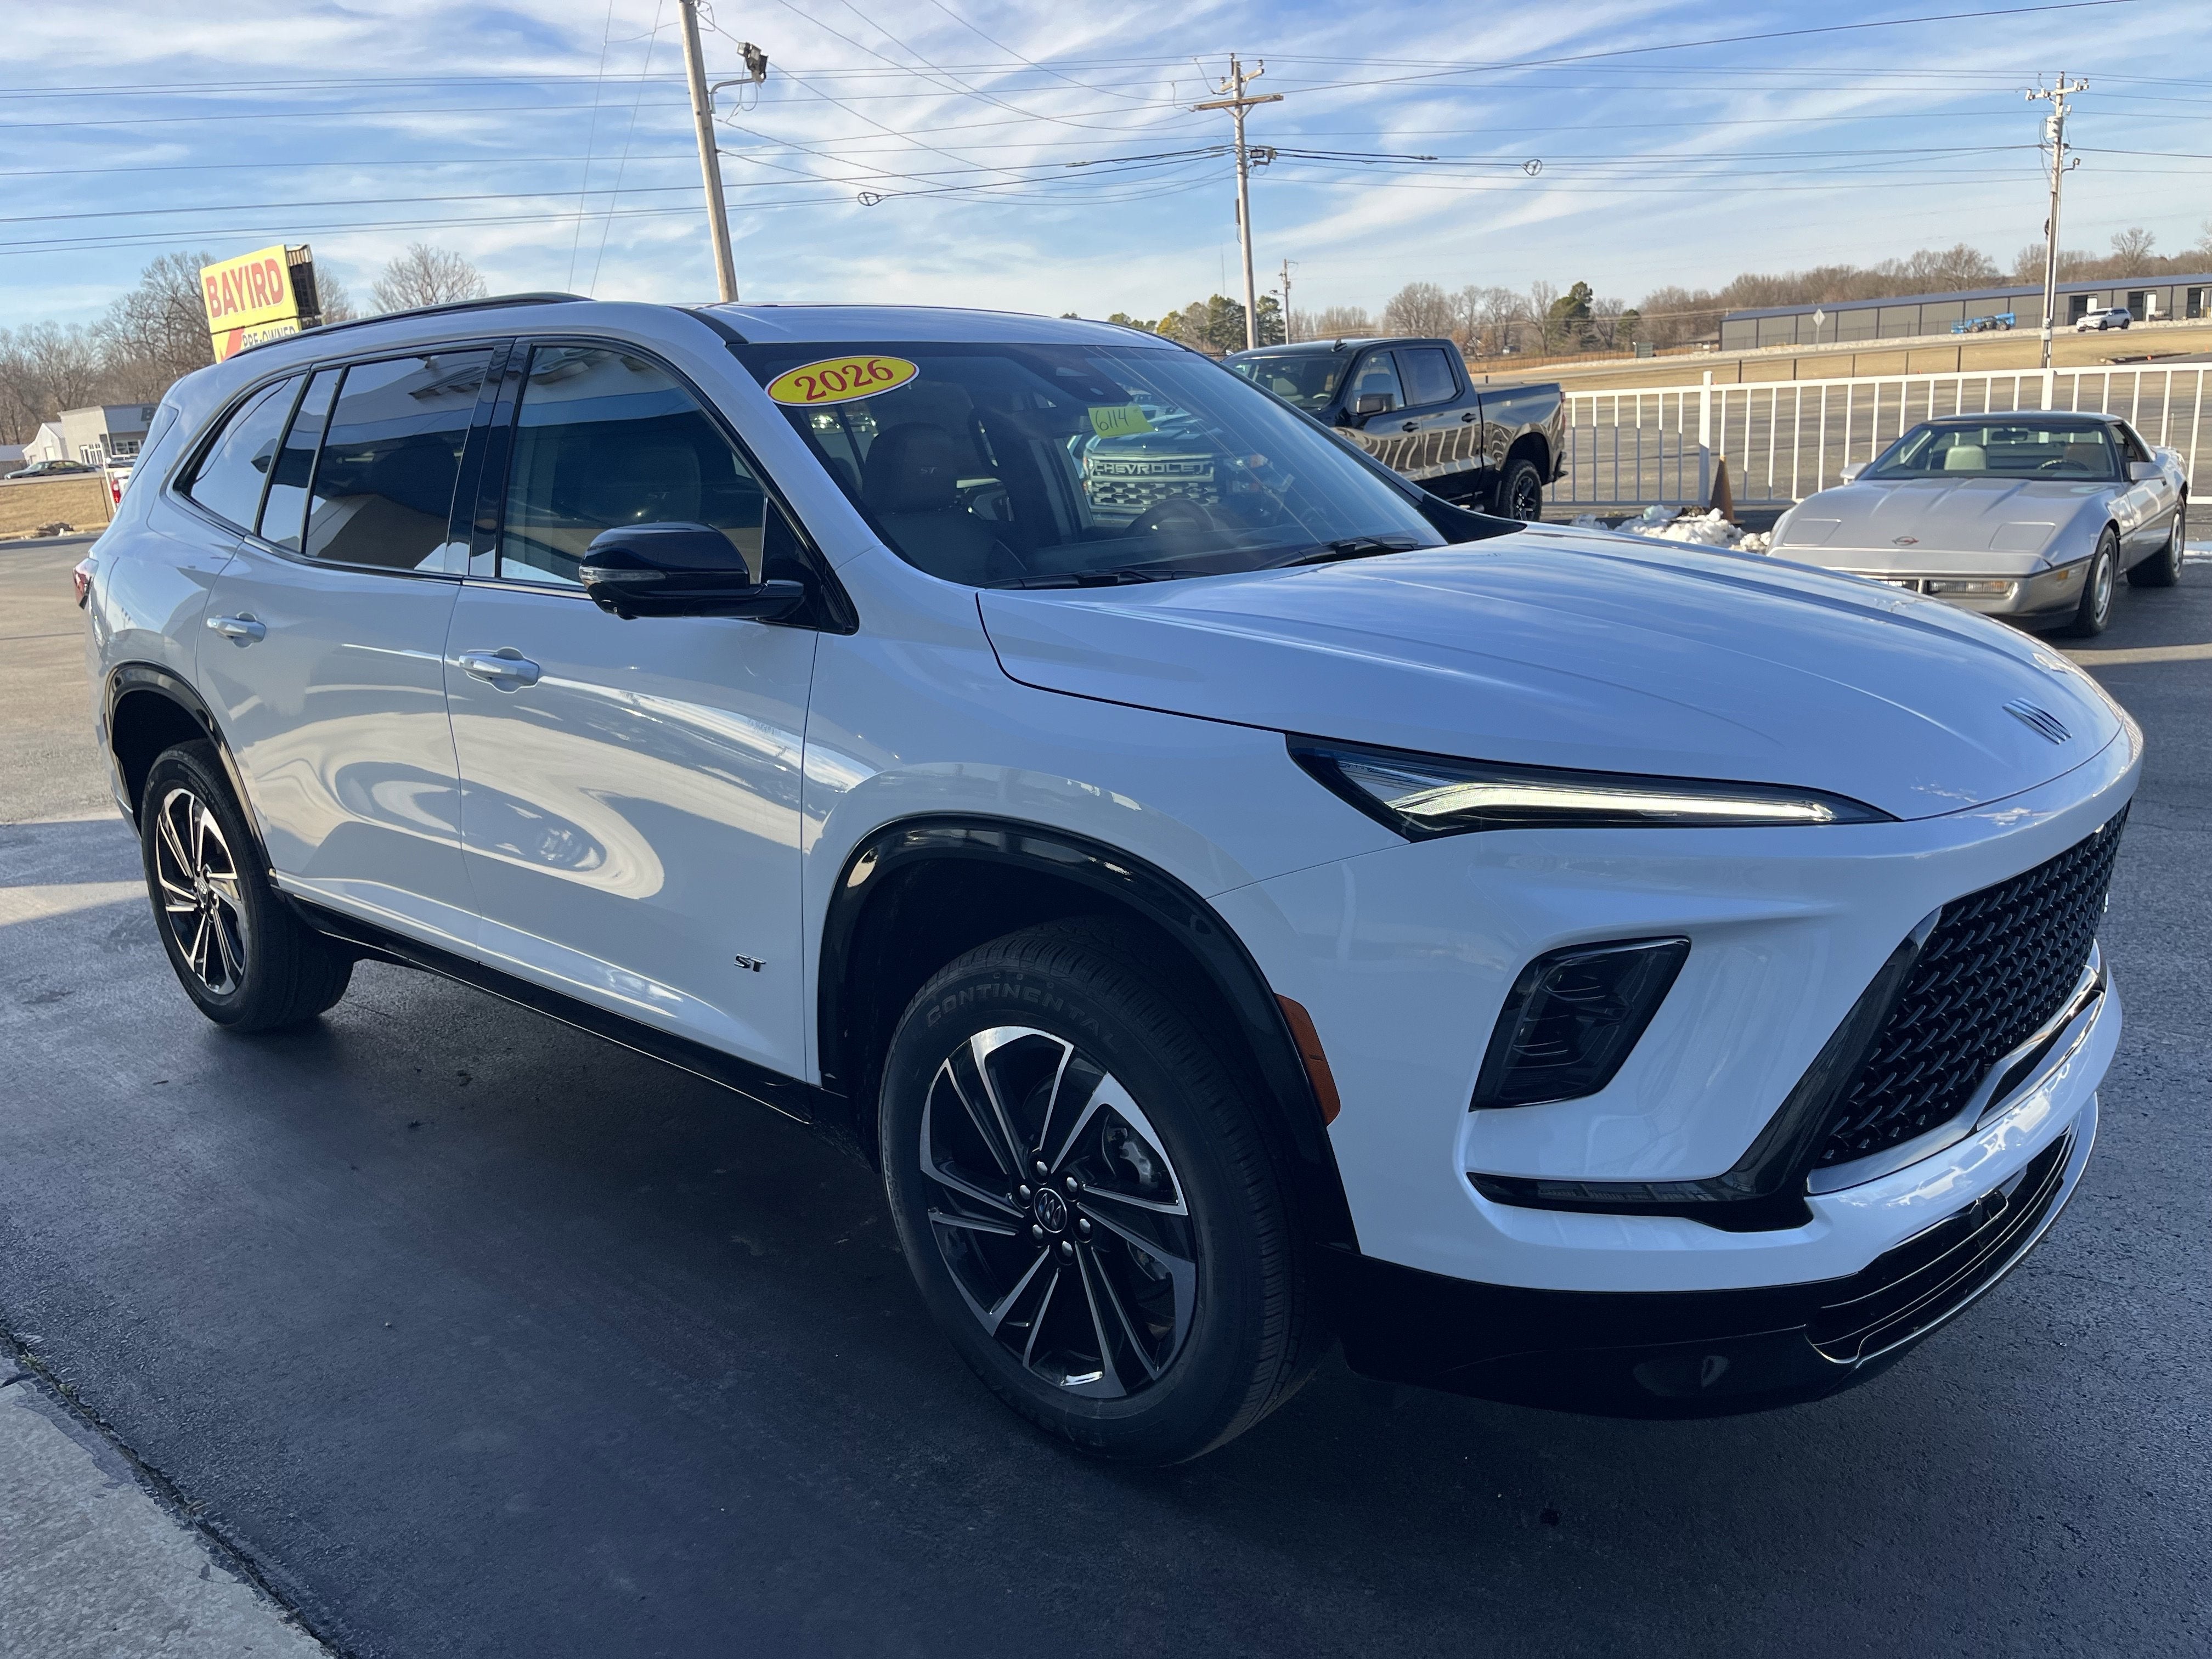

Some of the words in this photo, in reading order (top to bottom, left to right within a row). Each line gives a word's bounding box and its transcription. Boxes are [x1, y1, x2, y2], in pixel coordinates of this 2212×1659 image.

[205, 258, 284, 319] BAYIRD
[794, 359, 894, 401] 2026
[1095, 408, 1129, 431] 6114
[1094, 463, 1205, 475] CHEVROLET
[734, 953, 767, 972] ST
[926, 983, 1119, 1054] CONTINENTAL
